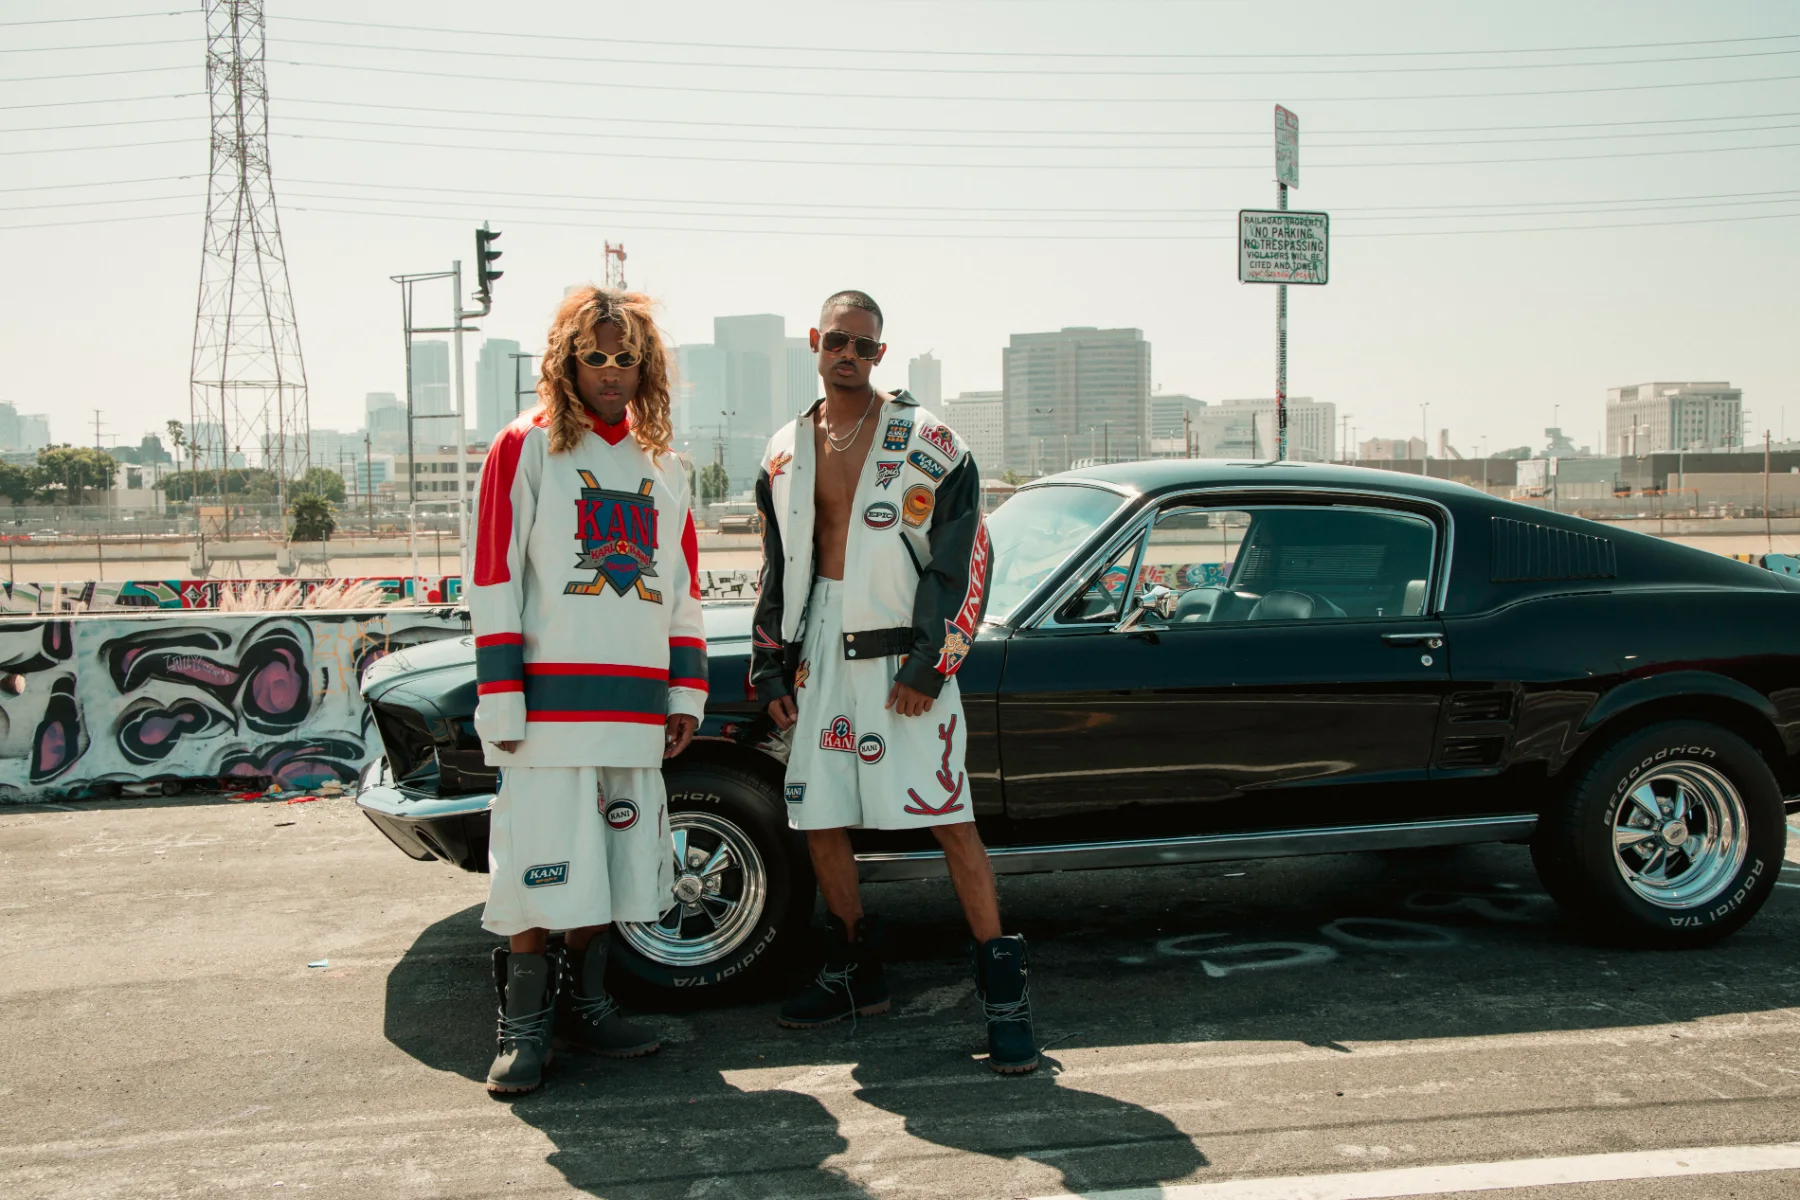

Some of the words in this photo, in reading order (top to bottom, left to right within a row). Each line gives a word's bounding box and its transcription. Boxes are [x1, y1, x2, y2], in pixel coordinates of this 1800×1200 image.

[1244, 216, 1282, 225] RAILROAD
[1285, 217, 1324, 227] PROPERTY
[1255, 227, 1268, 238] NO
[1272, 228, 1313, 239] PARKING
[1244, 239, 1257, 249] NO
[1260, 239, 1324, 252] TRESPASSING
[1247, 252, 1289, 260] VIOLATORS
[1292, 252, 1306, 261] WILL
[1311, 253, 1321, 261] BE
[1250, 261, 1271, 269] CITED
[1274, 262, 1290, 270] AND
[1293, 262, 1317, 271] TOWED
[922, 426, 958, 458] KANI
[918, 454, 944, 474] KANI
[868, 511, 893, 519] EPIC
[574, 499, 659, 549] KANI
[591, 543, 616, 559] KARL
[630, 545, 650, 567] KANI
[824, 732, 857, 750] KANI
[861, 744, 878, 753] KANI
[1603, 744, 1717, 826] BFGoodrich
[610, 810, 630, 820] KANI
[529, 866, 564, 880] KANI
[1710, 858, 1765, 922] Radial
[1669, 916, 1704, 928] T/A
[716, 926, 777, 983] Radial
[673, 976, 709, 987] T/A
